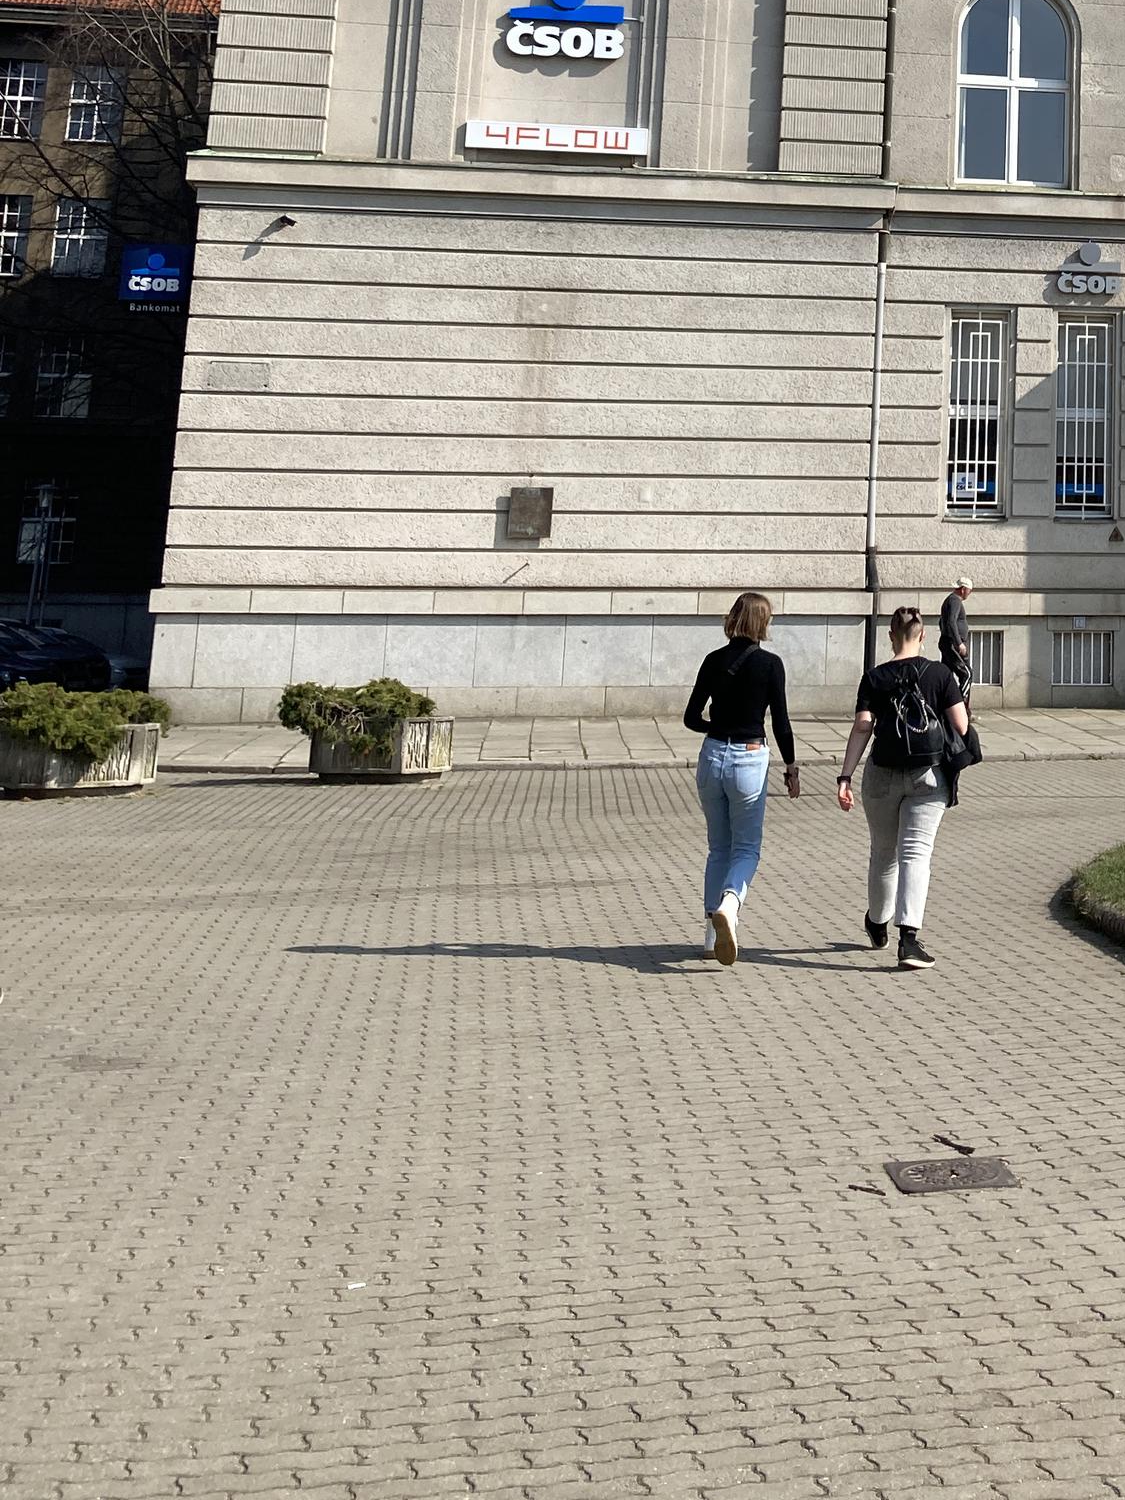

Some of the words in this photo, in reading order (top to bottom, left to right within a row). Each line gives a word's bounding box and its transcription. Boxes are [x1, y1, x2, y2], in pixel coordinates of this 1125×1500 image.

[505, 20, 625, 60] ČSOB
[486, 125, 629, 150] 4FLOW
[128, 276, 179, 292] ČSOB
[1057, 272, 1121, 294] ČSOB
[129, 303, 180, 312] Bankomat
